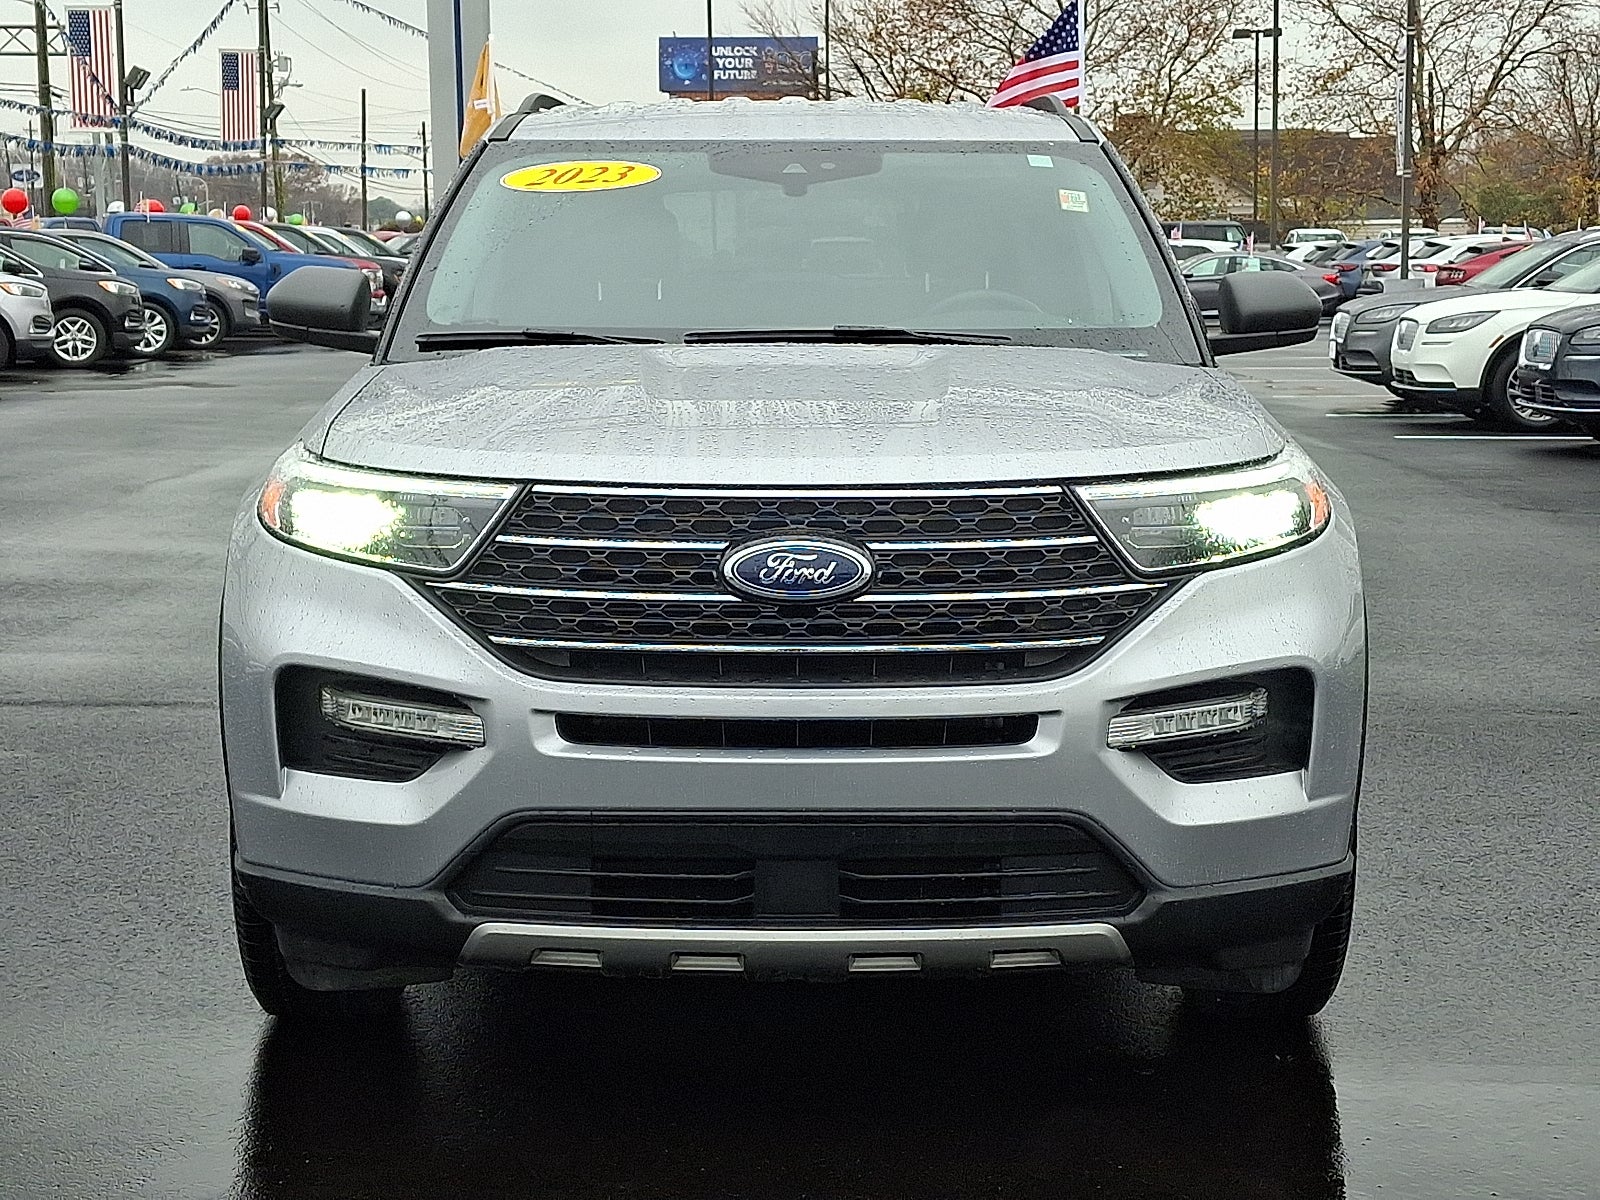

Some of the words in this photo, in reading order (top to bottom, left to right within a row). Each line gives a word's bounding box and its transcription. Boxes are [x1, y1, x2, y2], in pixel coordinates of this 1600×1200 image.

[711, 46, 758, 57] UNLOCK
[715, 57, 754, 69] YOUR
[713, 69, 758, 80] FUTURE
[524, 165, 635, 187] 2023
[759, 552, 839, 585] Ford
